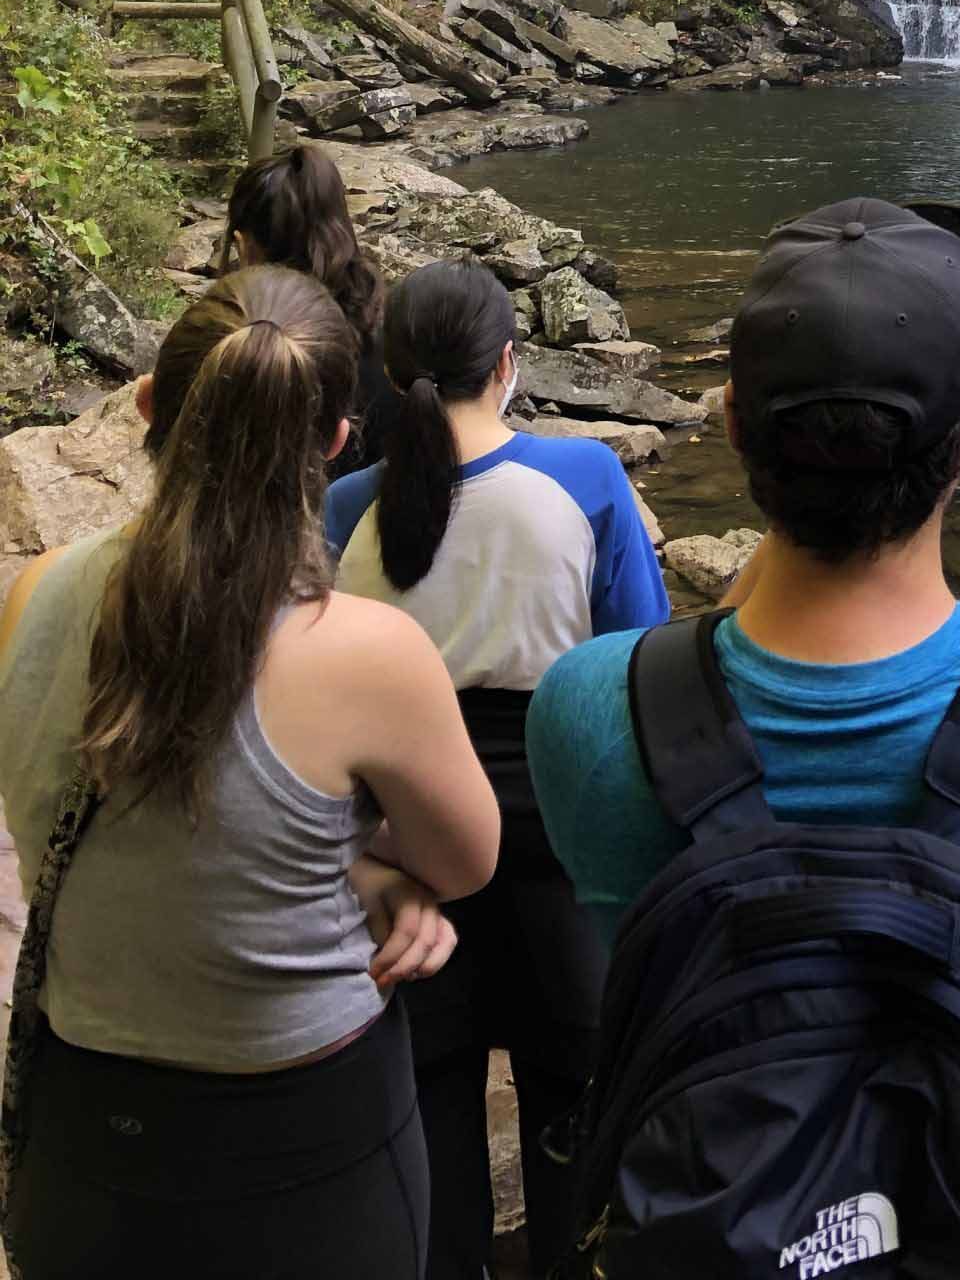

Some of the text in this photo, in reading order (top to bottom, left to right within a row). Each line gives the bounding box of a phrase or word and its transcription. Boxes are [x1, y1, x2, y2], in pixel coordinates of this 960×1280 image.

[815, 1195, 859, 1230] THE
[779, 1217, 858, 1269] NORTH
[799, 1238, 859, 1280] FACE
